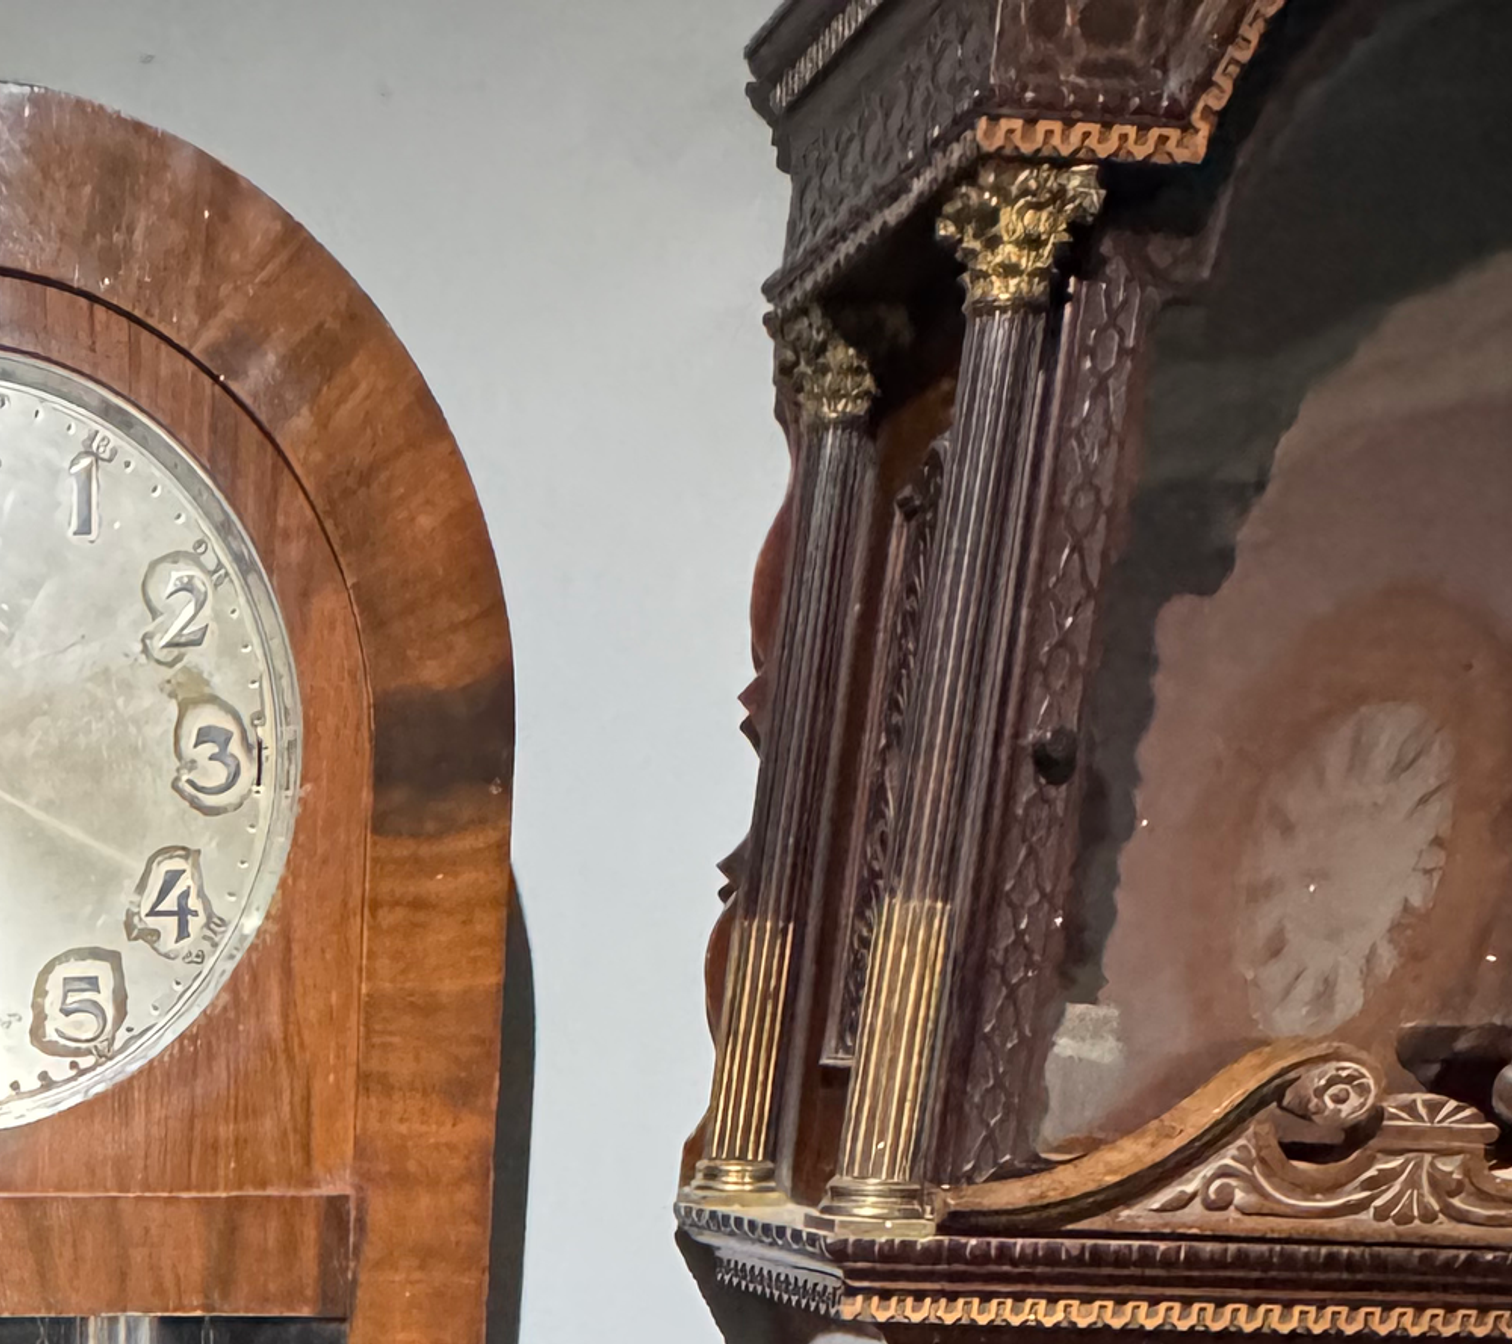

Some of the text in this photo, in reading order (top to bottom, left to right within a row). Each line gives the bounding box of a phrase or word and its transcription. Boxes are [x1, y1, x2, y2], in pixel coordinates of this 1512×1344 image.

[70, 456, 96, 536] 1
[159, 572, 209, 649] 2
[185, 725, 241, 796] 3
[145, 869, 199, 944] 4
[55, 975, 108, 1043] 5
